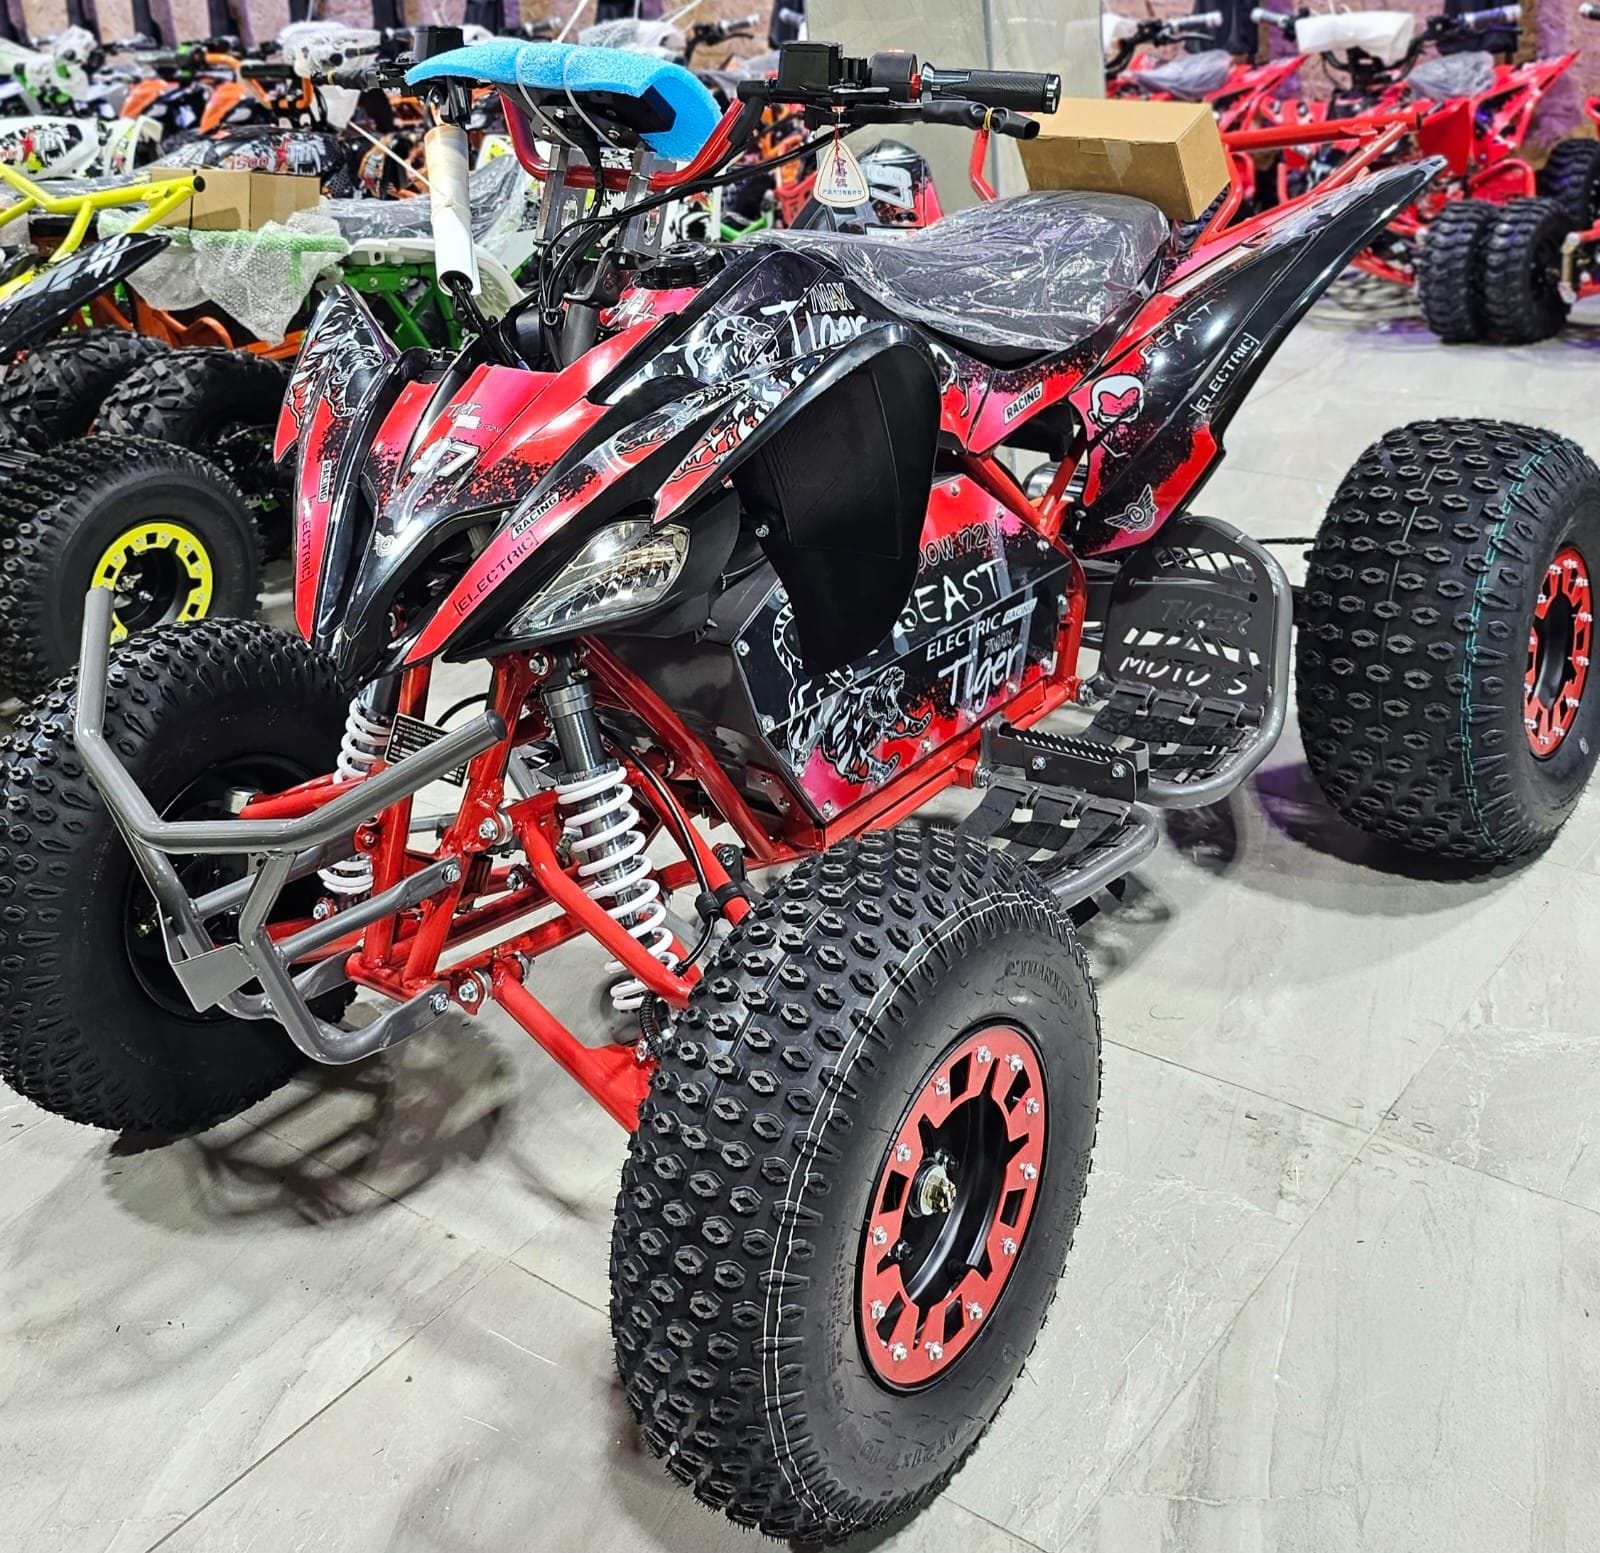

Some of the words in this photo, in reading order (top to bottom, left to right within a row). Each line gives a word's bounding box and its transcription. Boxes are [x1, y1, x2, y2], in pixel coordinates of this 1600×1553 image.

[1140, 298, 1217, 364] BEAST
[1005, 386, 1041, 420] RACING
[319, 461, 331, 501] RACING
[514, 495, 558, 535] RACING
[958, 517, 1000, 552] 72V
[926, 612, 1002, 662] ELECTRIC
[1161, 599, 1251, 636] TIGER
[938, 643, 1023, 713] Tiger
